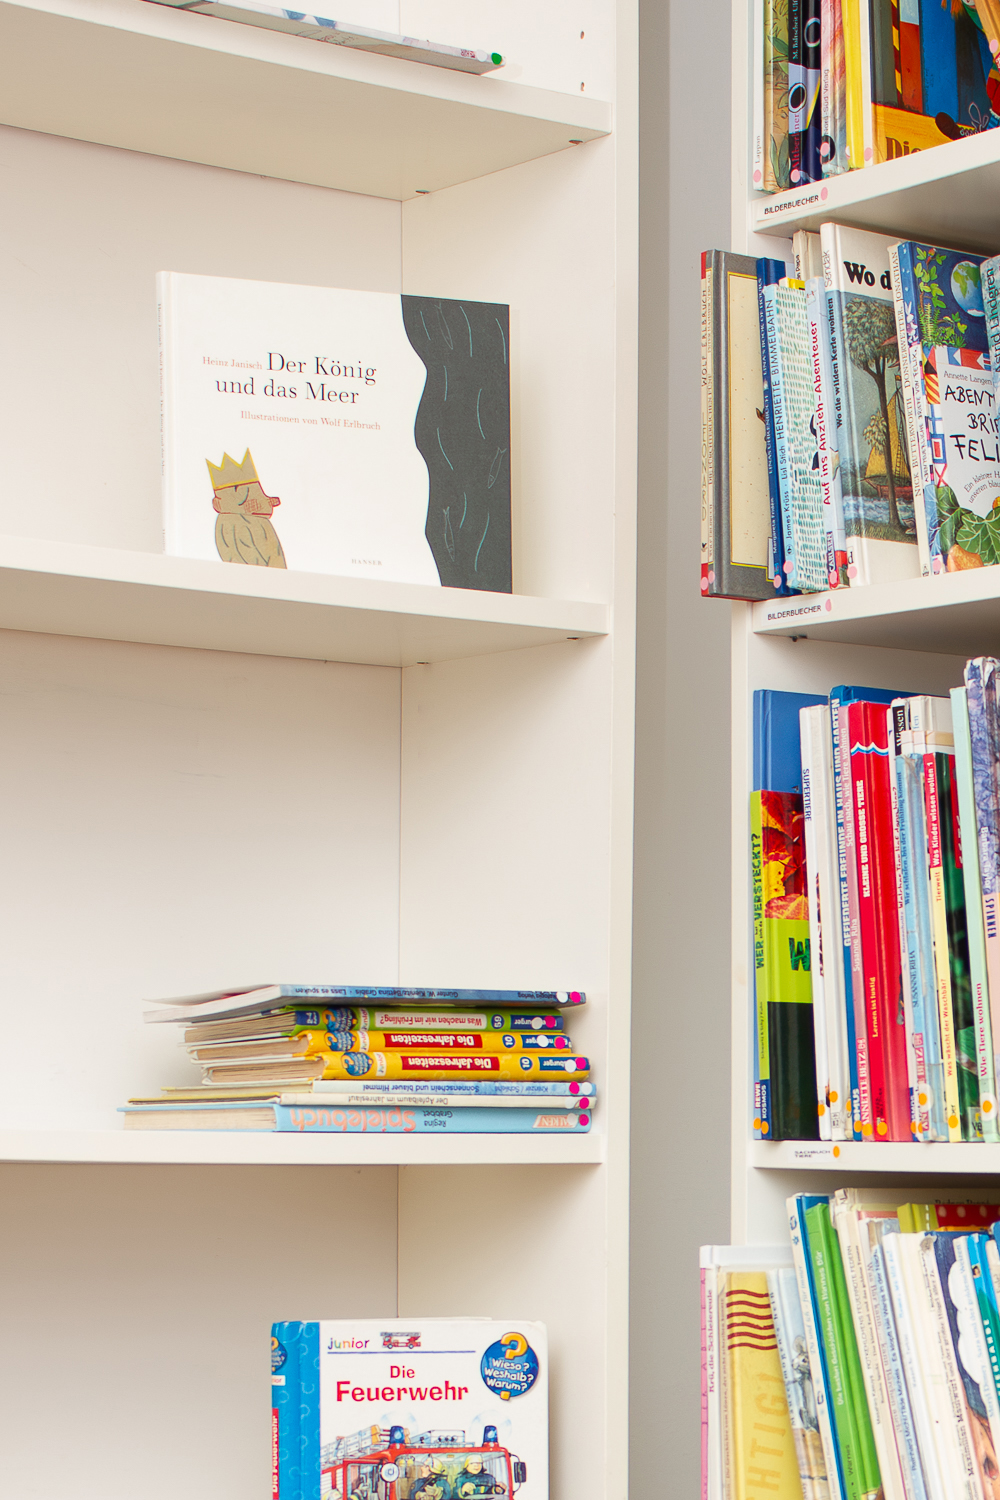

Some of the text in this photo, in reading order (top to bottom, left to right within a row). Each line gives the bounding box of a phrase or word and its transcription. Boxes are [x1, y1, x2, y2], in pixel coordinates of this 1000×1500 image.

[764, 194, 819, 215] BILDERBUECHER
[986, 267, 999, 328] Lindgren
[827, 297, 835, 334] wohnen
[765, 299, 778, 374] BIMMELBAHN
[202, 356, 262, 370] Heinz Janisch
[266, 352, 377, 386] Der König
[215, 377, 360, 404] und das Meer
[772, 380, 783, 439] HENRIETTE
[810, 321, 830, 505] Auf ins Anzieh-Abenteuer
[241, 411, 300, 424] Illustrationen
[320, 417, 341, 428] Wolf
[343, 420, 381, 431] Erlbruch
[835, 413, 842, 428] Wo
[767, 603, 822, 622] BILDERBUECHER
[802, 768, 811, 819] SUPERTIERE
[856, 780, 869, 897] KLEINE UND GROSSE TIERE
[751, 833, 764, 968] WER VERSTECKT?
[985, 898, 996, 938] SPINNEN
[380, 1014, 413, 1025] Frühling?
[425, 1016, 437, 1025] wir
[438, 1017, 466, 1025] machen
[467, 1018, 482, 1026] Was
[391, 1034, 475, 1047] Die Jahreszeiten
[290, 1106, 417, 1132] Spielebuch
[424, 1119, 447, 1128] Regina
[327, 1337, 370, 1350] junior
[390, 1365, 416, 1380] Die
[484, 1367, 534, 1383] Weshalb?
[492, 1359, 530, 1371] Wieso?
[336, 1380, 469, 1402] Feuerwehr
[485, 1377, 528, 1392] Warum?
